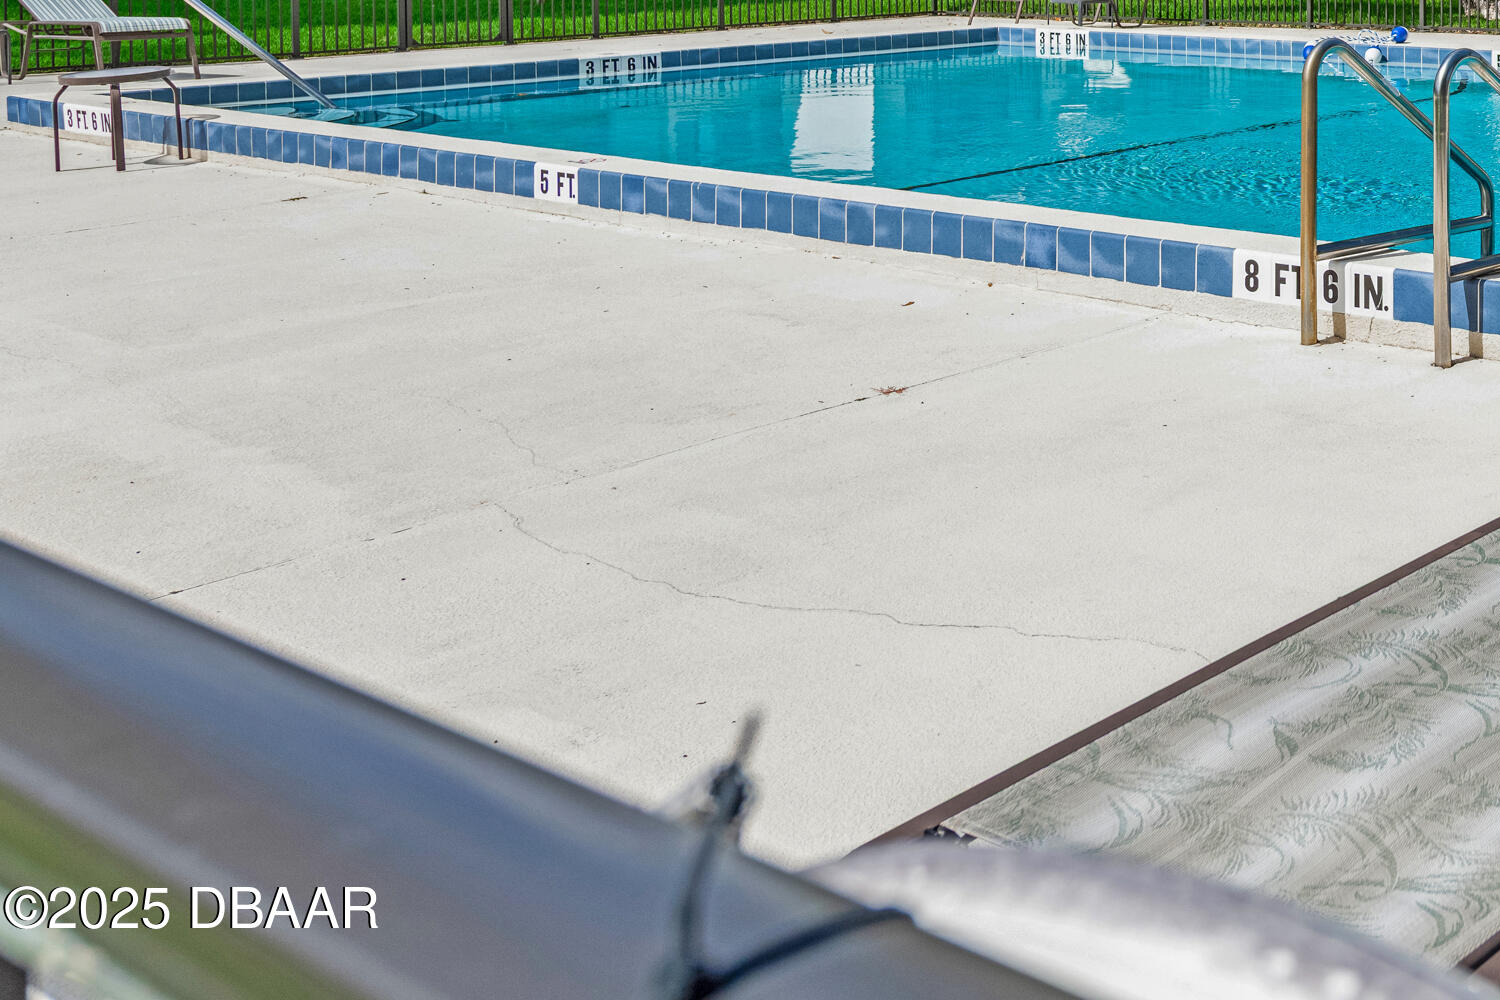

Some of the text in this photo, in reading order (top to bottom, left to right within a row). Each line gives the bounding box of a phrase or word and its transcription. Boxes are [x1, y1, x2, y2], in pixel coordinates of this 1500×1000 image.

[1039, 32, 1045, 45] 3
[1065, 33, 1071, 45] 6
[585, 60, 595, 75] 3
[627, 57, 636, 72] 6
[67, 108, 73, 128] 3
[91, 111, 98, 131] 6
[540, 169, 576, 199] 5 FT.
[1244, 259, 1259, 292] 8
[1323, 269, 1339, 304] 6
[1354, 273, 1389, 312] IN.
